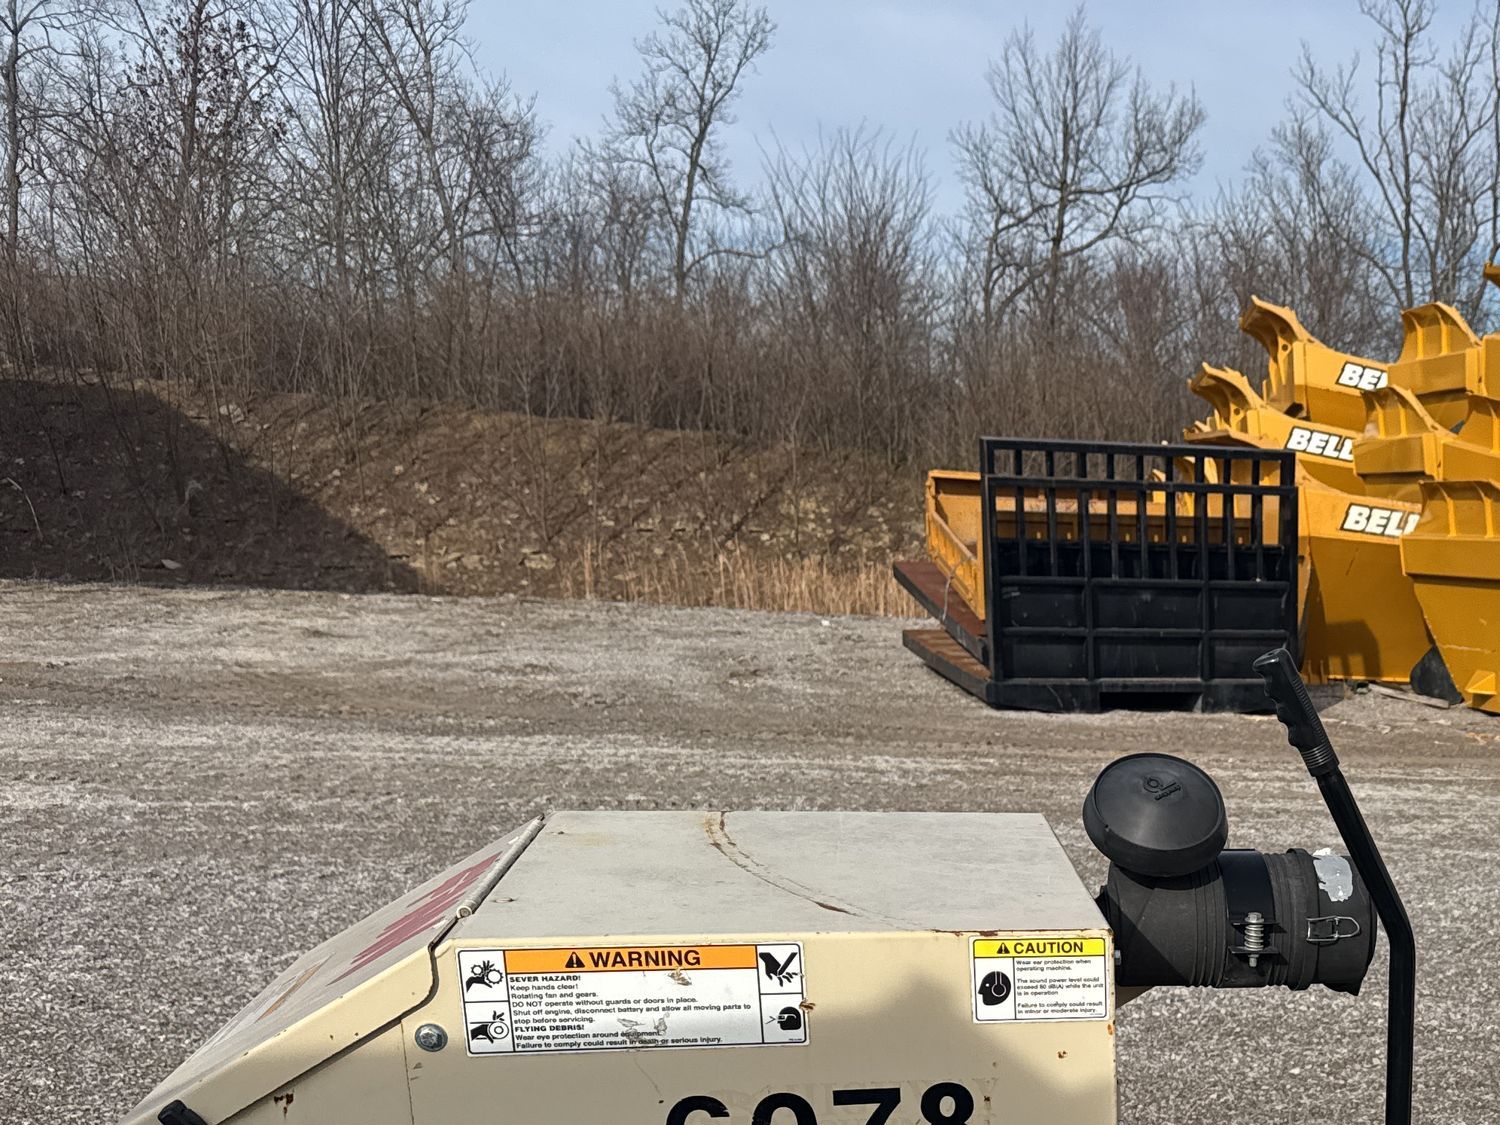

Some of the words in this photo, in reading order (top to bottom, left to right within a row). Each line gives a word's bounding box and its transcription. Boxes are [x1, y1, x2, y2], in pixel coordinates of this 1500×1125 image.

[1013, 941, 1084, 954] CAUTION
[590, 950, 701, 968] WARNING
[618, 1006, 643, 1014] battery
